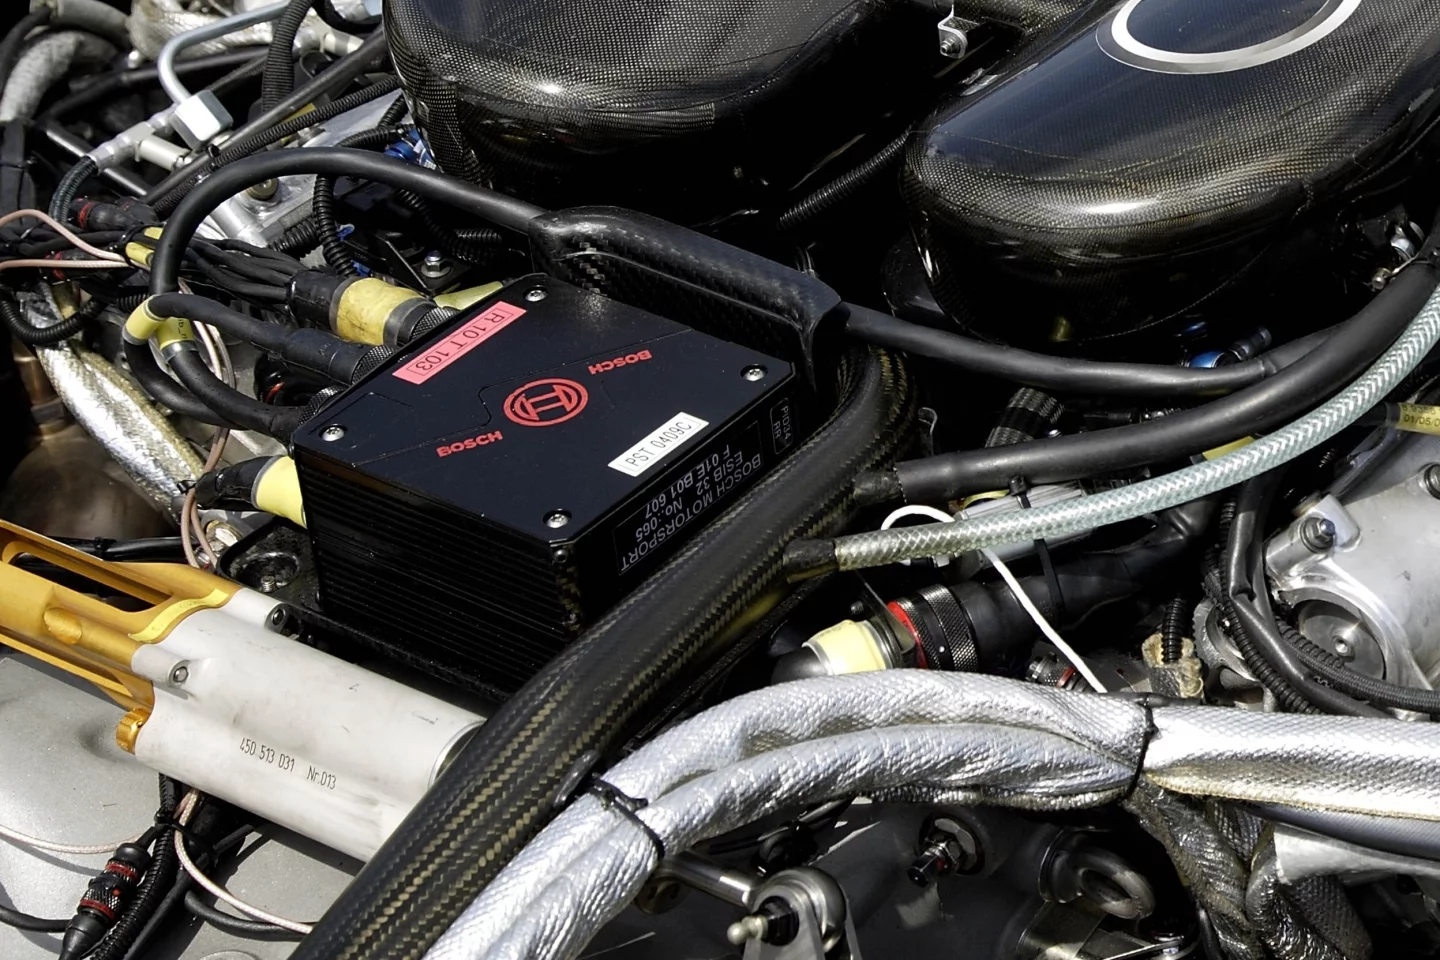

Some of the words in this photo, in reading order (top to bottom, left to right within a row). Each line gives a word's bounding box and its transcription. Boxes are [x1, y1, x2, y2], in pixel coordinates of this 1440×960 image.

[484, 312, 505, 323] R
[462, 324, 486, 339] 10
[450, 340, 468, 350] T
[415, 350, 450, 371] 103
[587, 349, 653, 376] BOSCH
[436, 430, 504, 458] BOSCH
[624, 446, 656, 467] PST
[650, 420, 692, 449] 0409C
[723, 444, 730, 458] F
[695, 452, 720, 475] 01E
[713, 450, 744, 483] ESIB
[716, 453, 762, 497] BOSCH
[669, 474, 694, 496] B01
[696, 480, 711, 496] 32
[644, 493, 667, 518] 607
[620, 492, 713, 572] MOTORSPORT
[239, 737, 257, 756] 450
[258, 744, 276, 764] 513
[277, 753, 295, 773] 031
[306, 765, 337, 790] Nr.013
